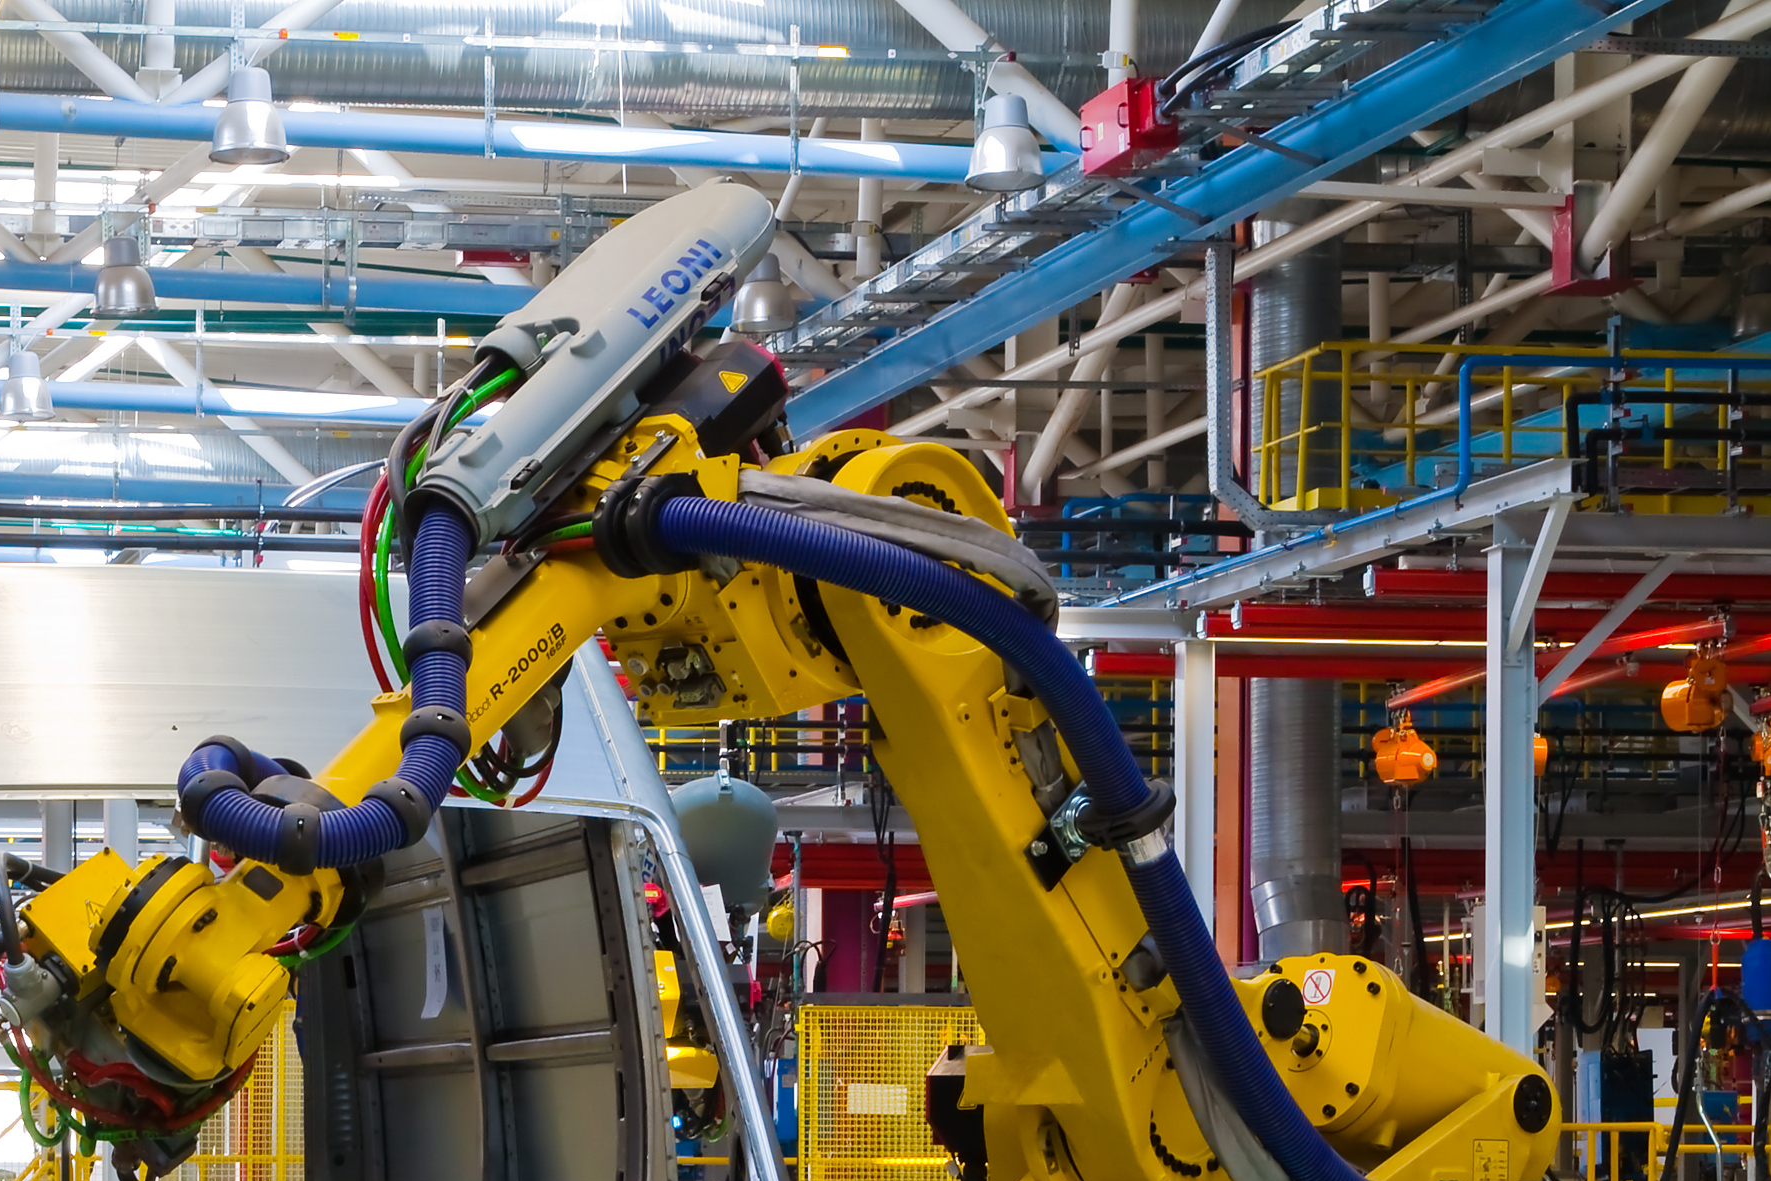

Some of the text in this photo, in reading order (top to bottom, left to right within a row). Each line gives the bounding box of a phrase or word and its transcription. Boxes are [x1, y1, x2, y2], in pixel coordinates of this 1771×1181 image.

[626, 238, 723, 330] LEONI
[489, 622, 565, 701] R-2000iB
[545, 635, 568, 661] 165F
